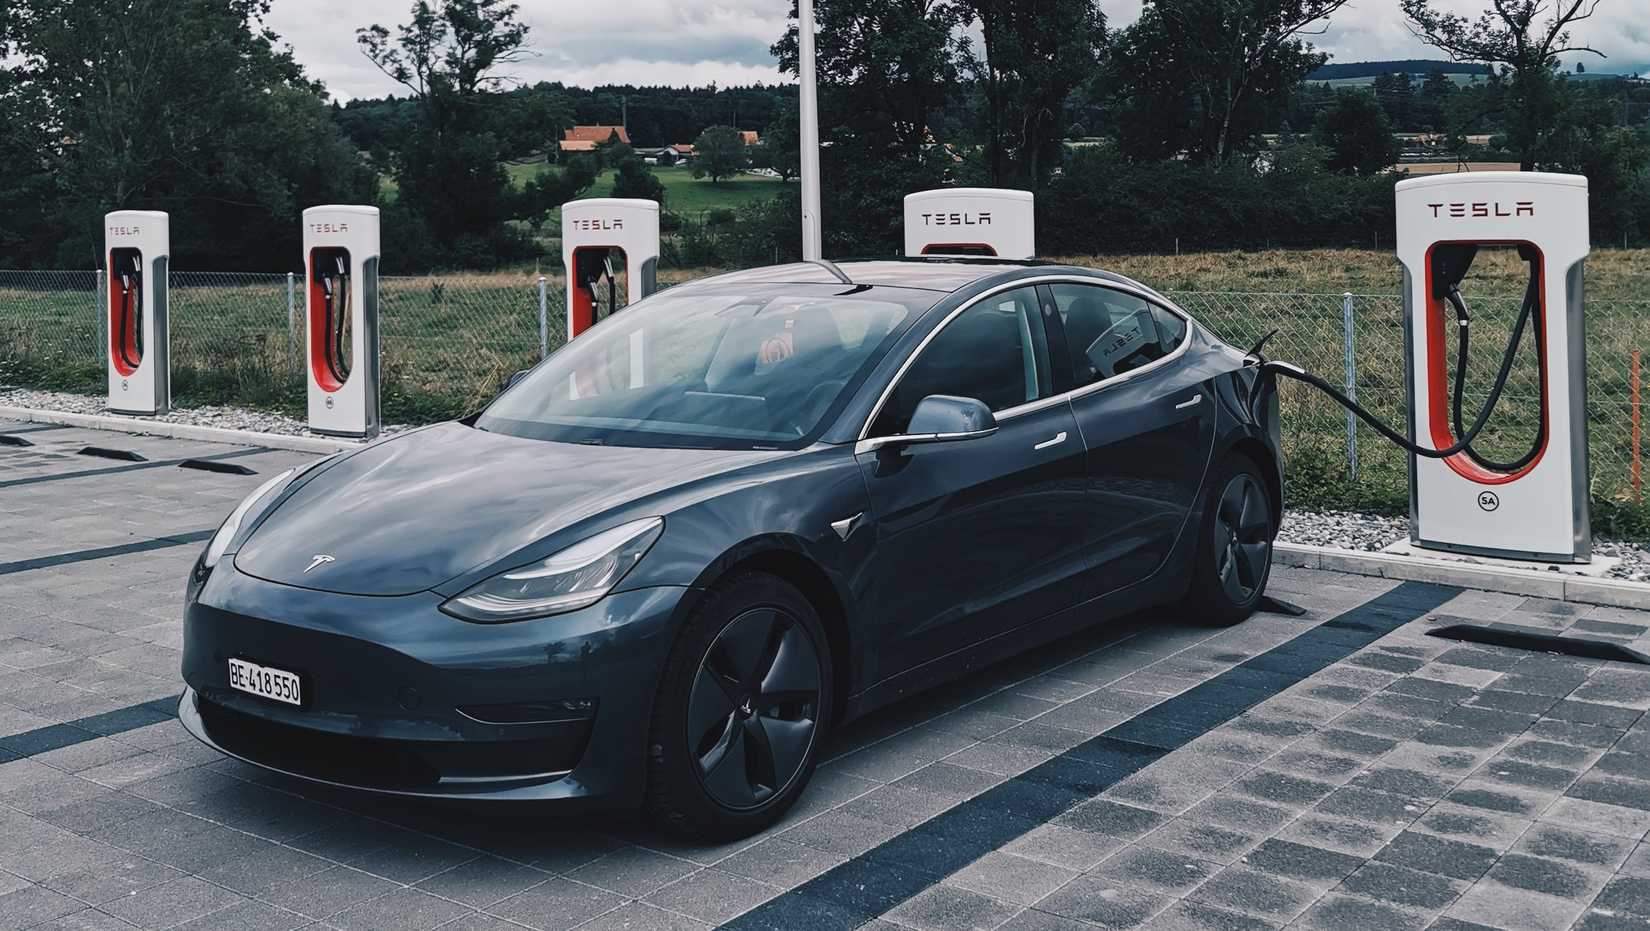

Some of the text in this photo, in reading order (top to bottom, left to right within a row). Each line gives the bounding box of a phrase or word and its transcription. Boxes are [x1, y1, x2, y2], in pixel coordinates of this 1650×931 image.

[1427, 201, 1534, 218] TESLA
[573, 219, 623, 230] TESLA
[921, 212, 991, 226] TESLA
[310, 223, 349, 233] TESLA
